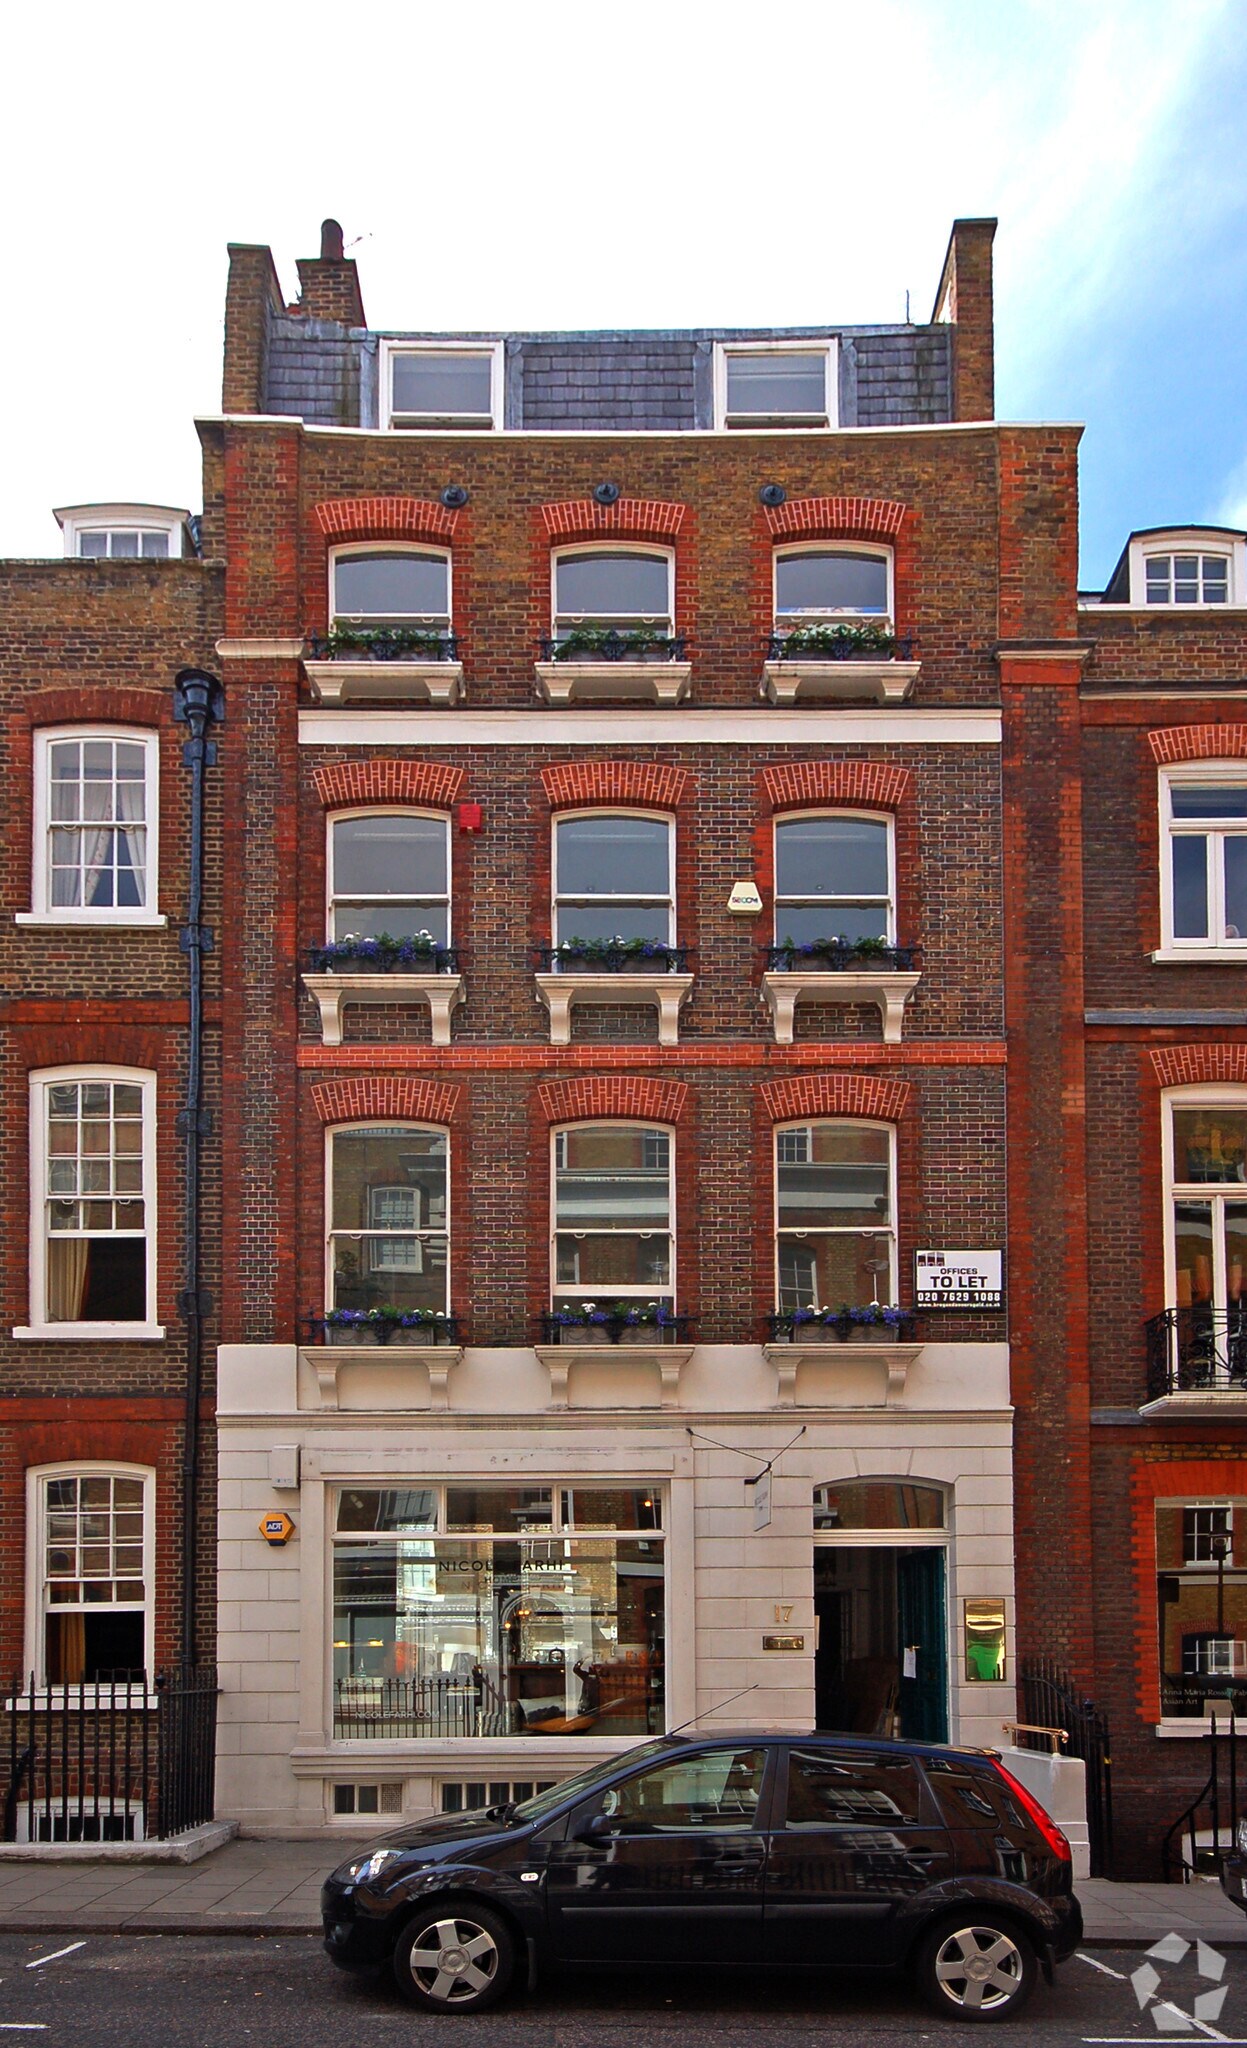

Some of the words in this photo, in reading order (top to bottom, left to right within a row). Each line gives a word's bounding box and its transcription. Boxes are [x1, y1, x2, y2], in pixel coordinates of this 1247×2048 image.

[930, 1276, 953, 1288] TO
[958, 1276, 988, 1288] LET
[917, 1292, 938, 1301] 020
[943, 1292, 969, 1301] 7629
[974, 1292, 1000, 1301] 1088
[267, 1522, 282, 1530] ADT
[439, 1561, 502, 1571] NICOL
[515, 1560, 563, 1570] ARHI
[775, 1604, 793, 1622] 17
